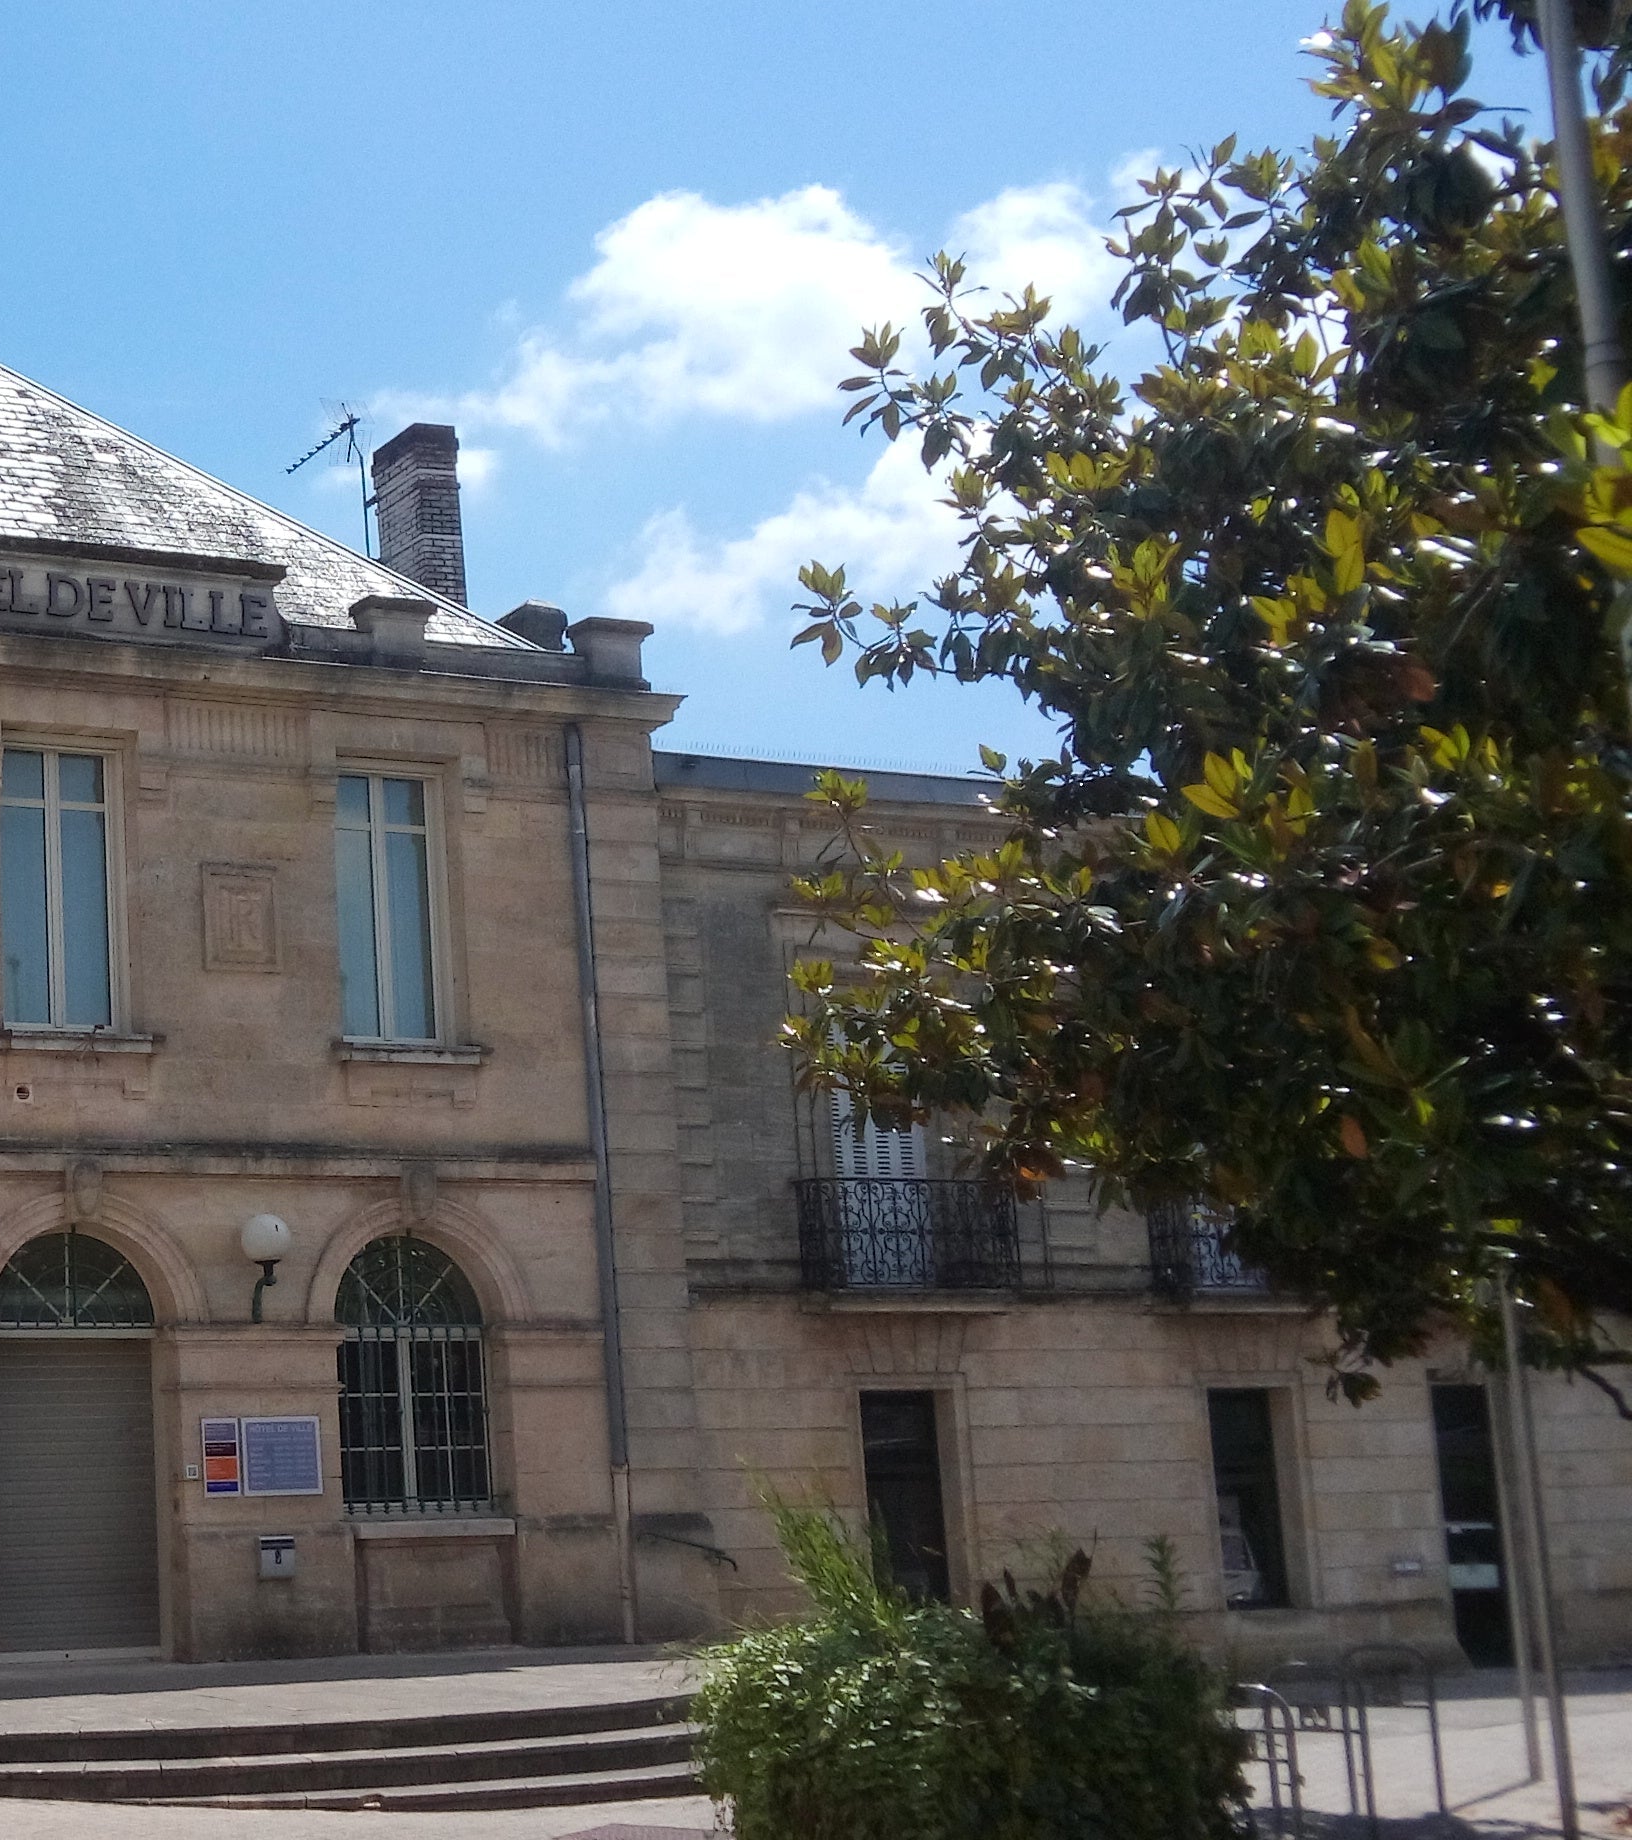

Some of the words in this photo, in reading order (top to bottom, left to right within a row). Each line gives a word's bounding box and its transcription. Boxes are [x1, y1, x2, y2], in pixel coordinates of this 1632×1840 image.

[46, 572, 116, 622] DE
[124, 580, 269, 638] VILLE
[277, 1424, 289, 1433] DE
